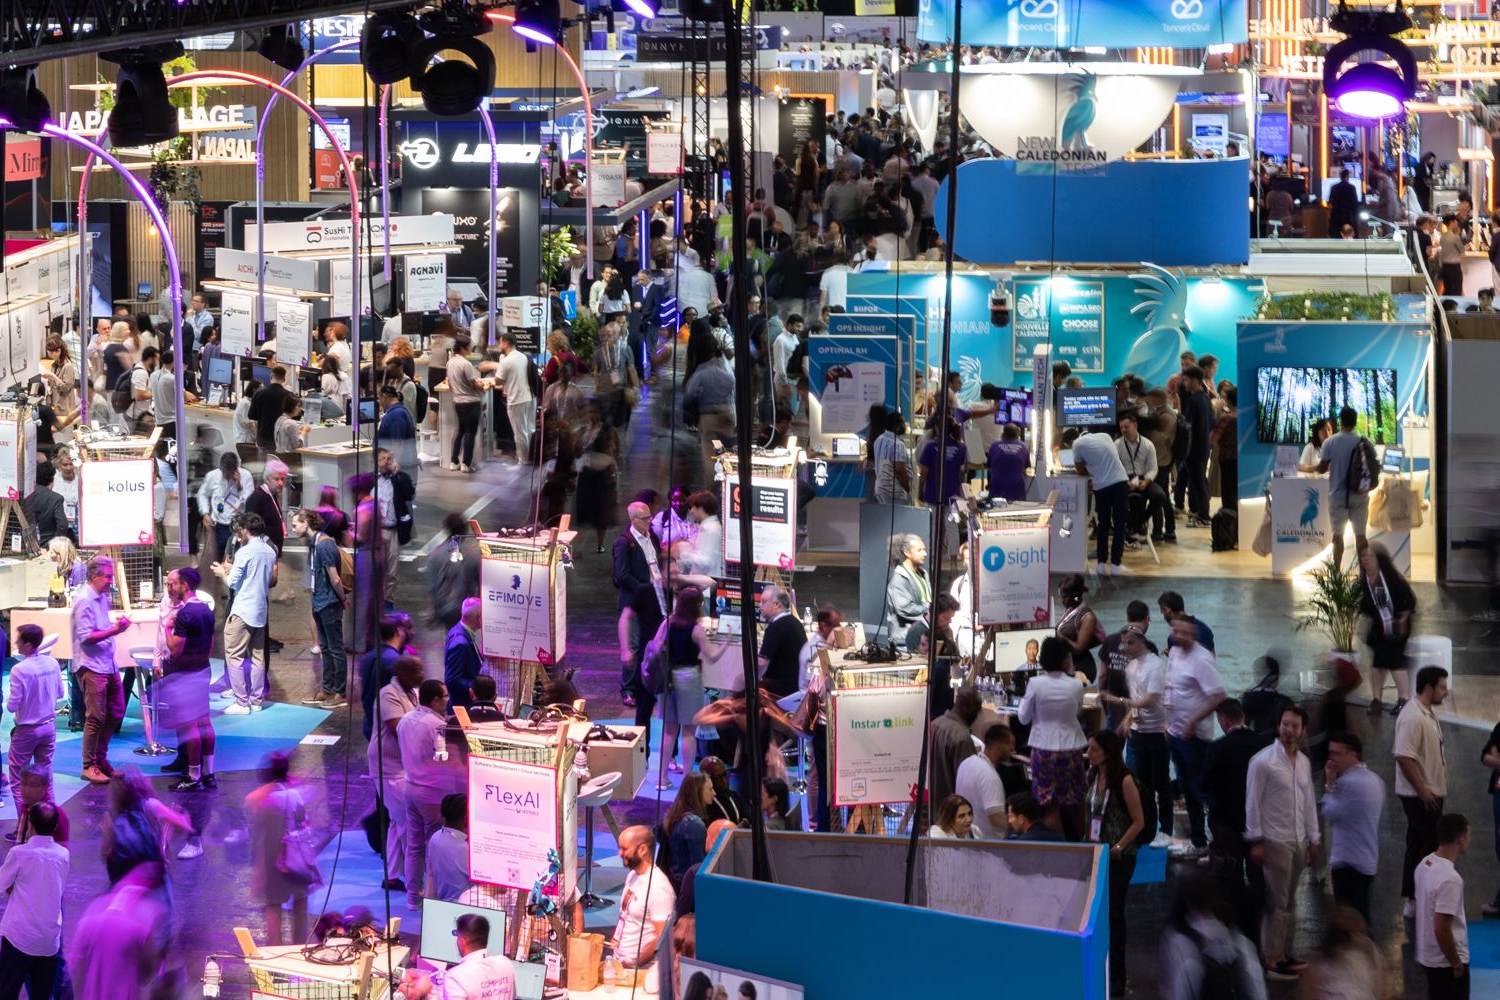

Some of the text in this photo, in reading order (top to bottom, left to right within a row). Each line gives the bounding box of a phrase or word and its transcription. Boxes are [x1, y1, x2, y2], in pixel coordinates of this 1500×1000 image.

[1017, 136, 1054, 150] NEW
[1016, 151, 1107, 161] CALEDONIAN
[837, 324, 886, 333] OPS INSIGHT
[1062, 320, 1098, 328] CHOOSE
[818, 346, 868, 355] OPTIMAL RH
[108, 480, 146, 493] kolus
[760, 504, 784, 514] results
[1276, 529, 1325, 537] CALEDONIAN
[488, 590, 542, 607] EFIMOVE
[851, 719, 881, 729] Instar
[485, 784, 540, 809] FlexAI
